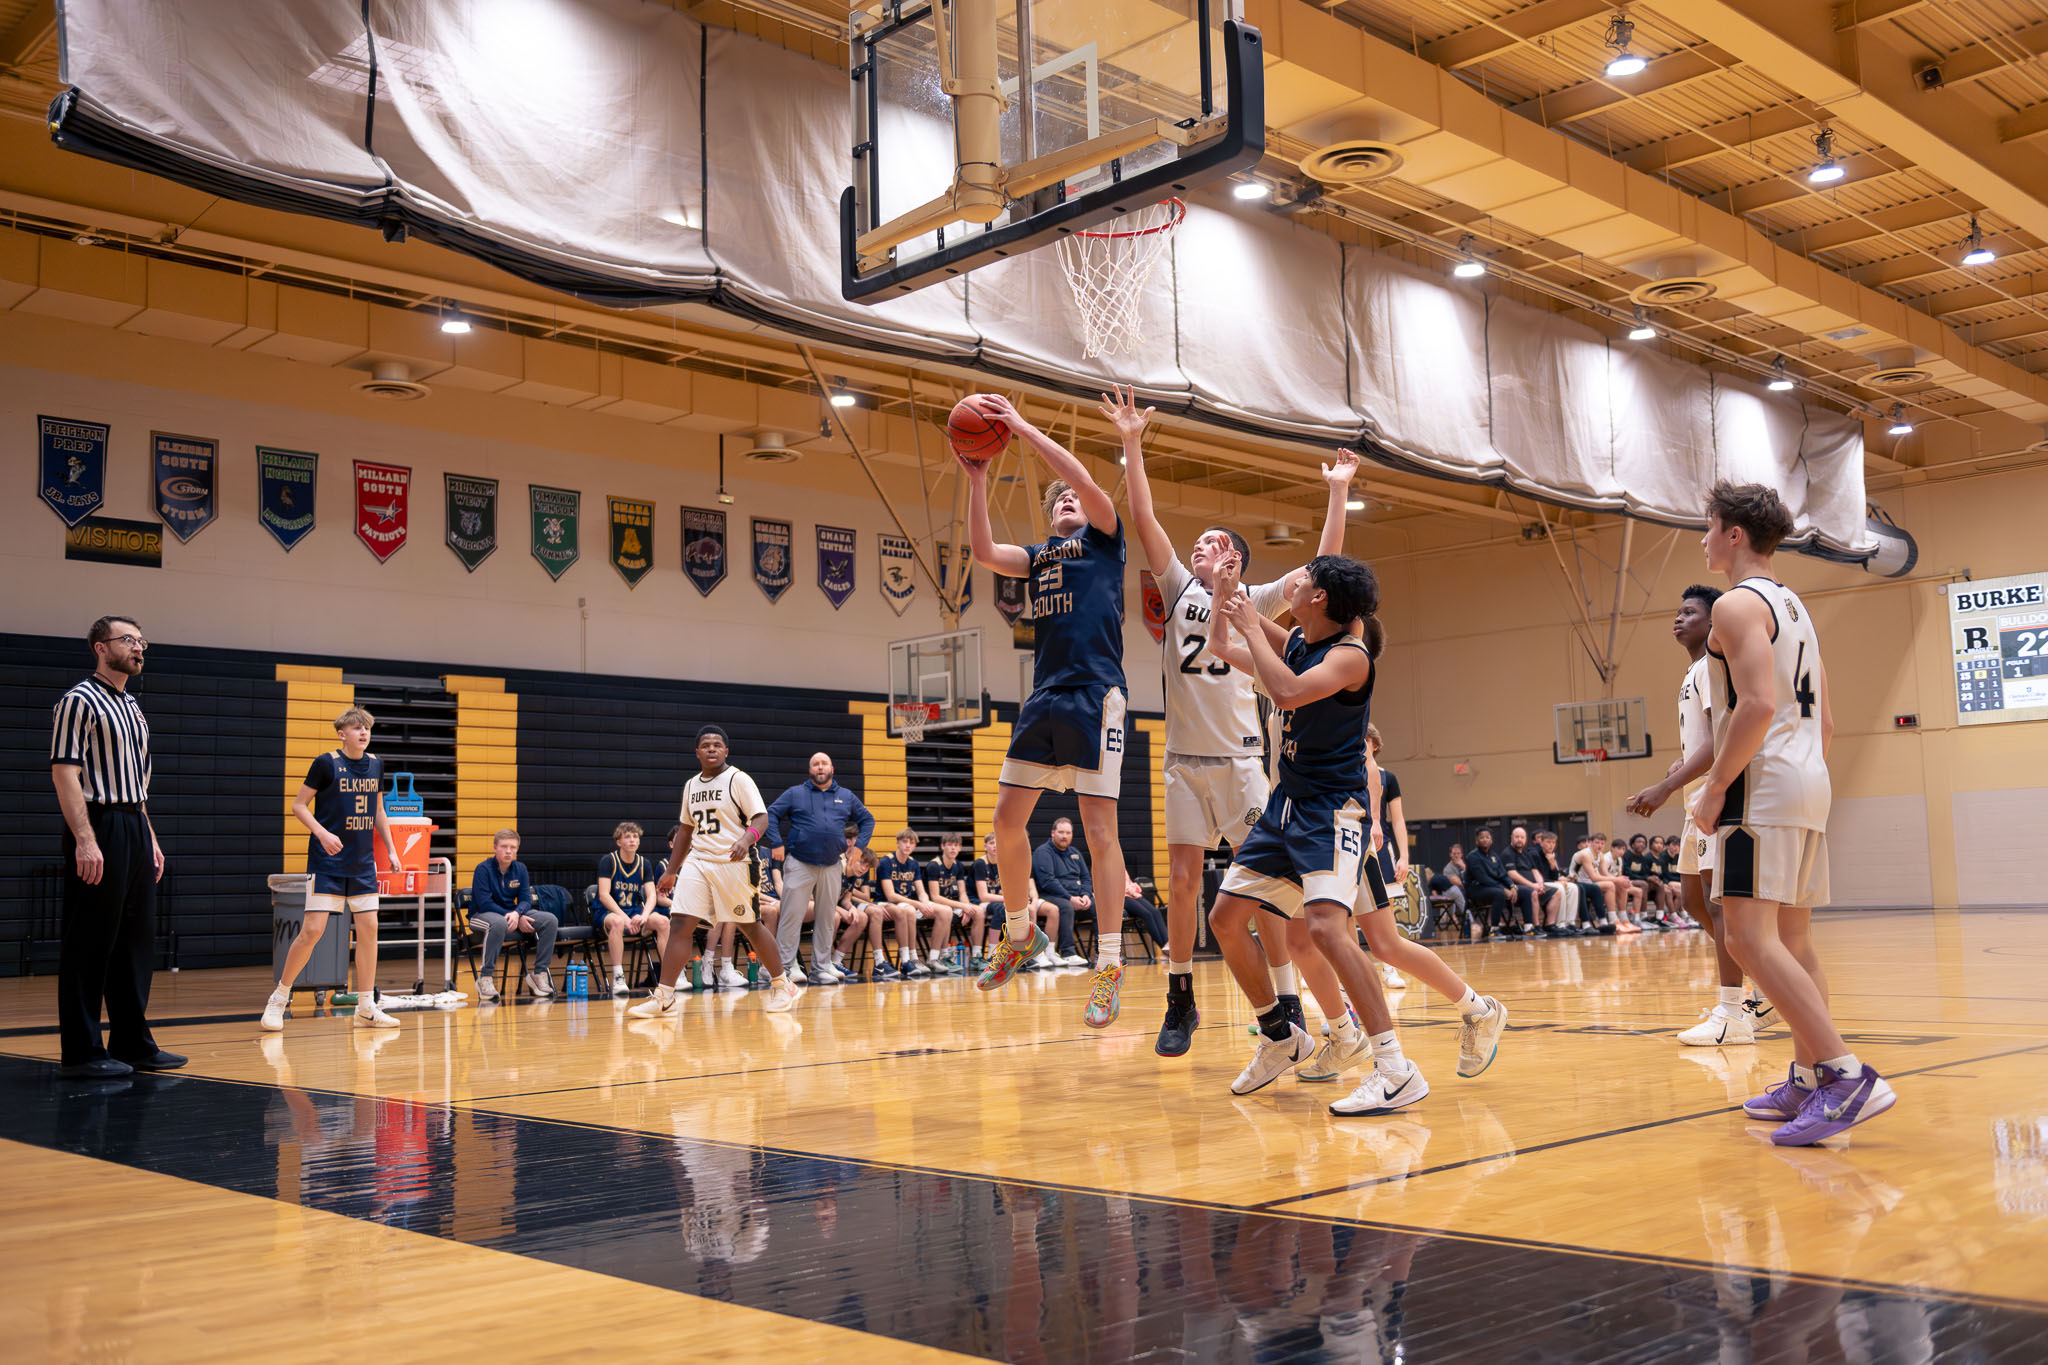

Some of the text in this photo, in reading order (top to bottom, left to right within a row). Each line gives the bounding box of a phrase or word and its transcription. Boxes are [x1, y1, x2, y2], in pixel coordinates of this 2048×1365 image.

[44, 423, 104, 441] CREIGHTON
[54, 437, 93, 453] PREP
[158, 441, 212, 457] ELKHORN
[161, 455, 208, 471] SOUTH
[262, 454, 313, 470] MILLARD
[265, 467, 310, 483] NORTH
[358, 469, 408, 484] MILLARD
[46, 487, 99, 506] JR. JAYS
[181, 485, 208, 495] STORM
[363, 482, 402, 496] SOUTH
[535, 491, 575, 505] OMAHA
[161, 503, 206, 521] STORM
[613, 502, 650, 515] OMAHA
[614, 514, 649, 527] BRYAN
[71, 526, 161, 553] VISITOR
[361, 523, 406, 542] PATRIOTS
[820, 530, 852, 543] OMAHA
[819, 540, 854, 553] CENTRAL
[1957, 585, 2040, 610] BURKE
[1033, 592, 1073, 620] SOUTH
[1961, 662, 1968, 670] 5
[2013, 666, 2023, 678] 1
[1793, 639, 1816, 720] 4
[1964, 703, 1971, 711] 4
[1106, 728, 1122, 753] ES
[339, 777, 380, 792] ELKHORN
[355, 795, 368, 814] 21
[691, 789, 723, 804] BURKE
[345, 816, 374, 830] SOUTH
[692, 808, 721, 835] 25
[1341, 827, 1359, 856] ES
